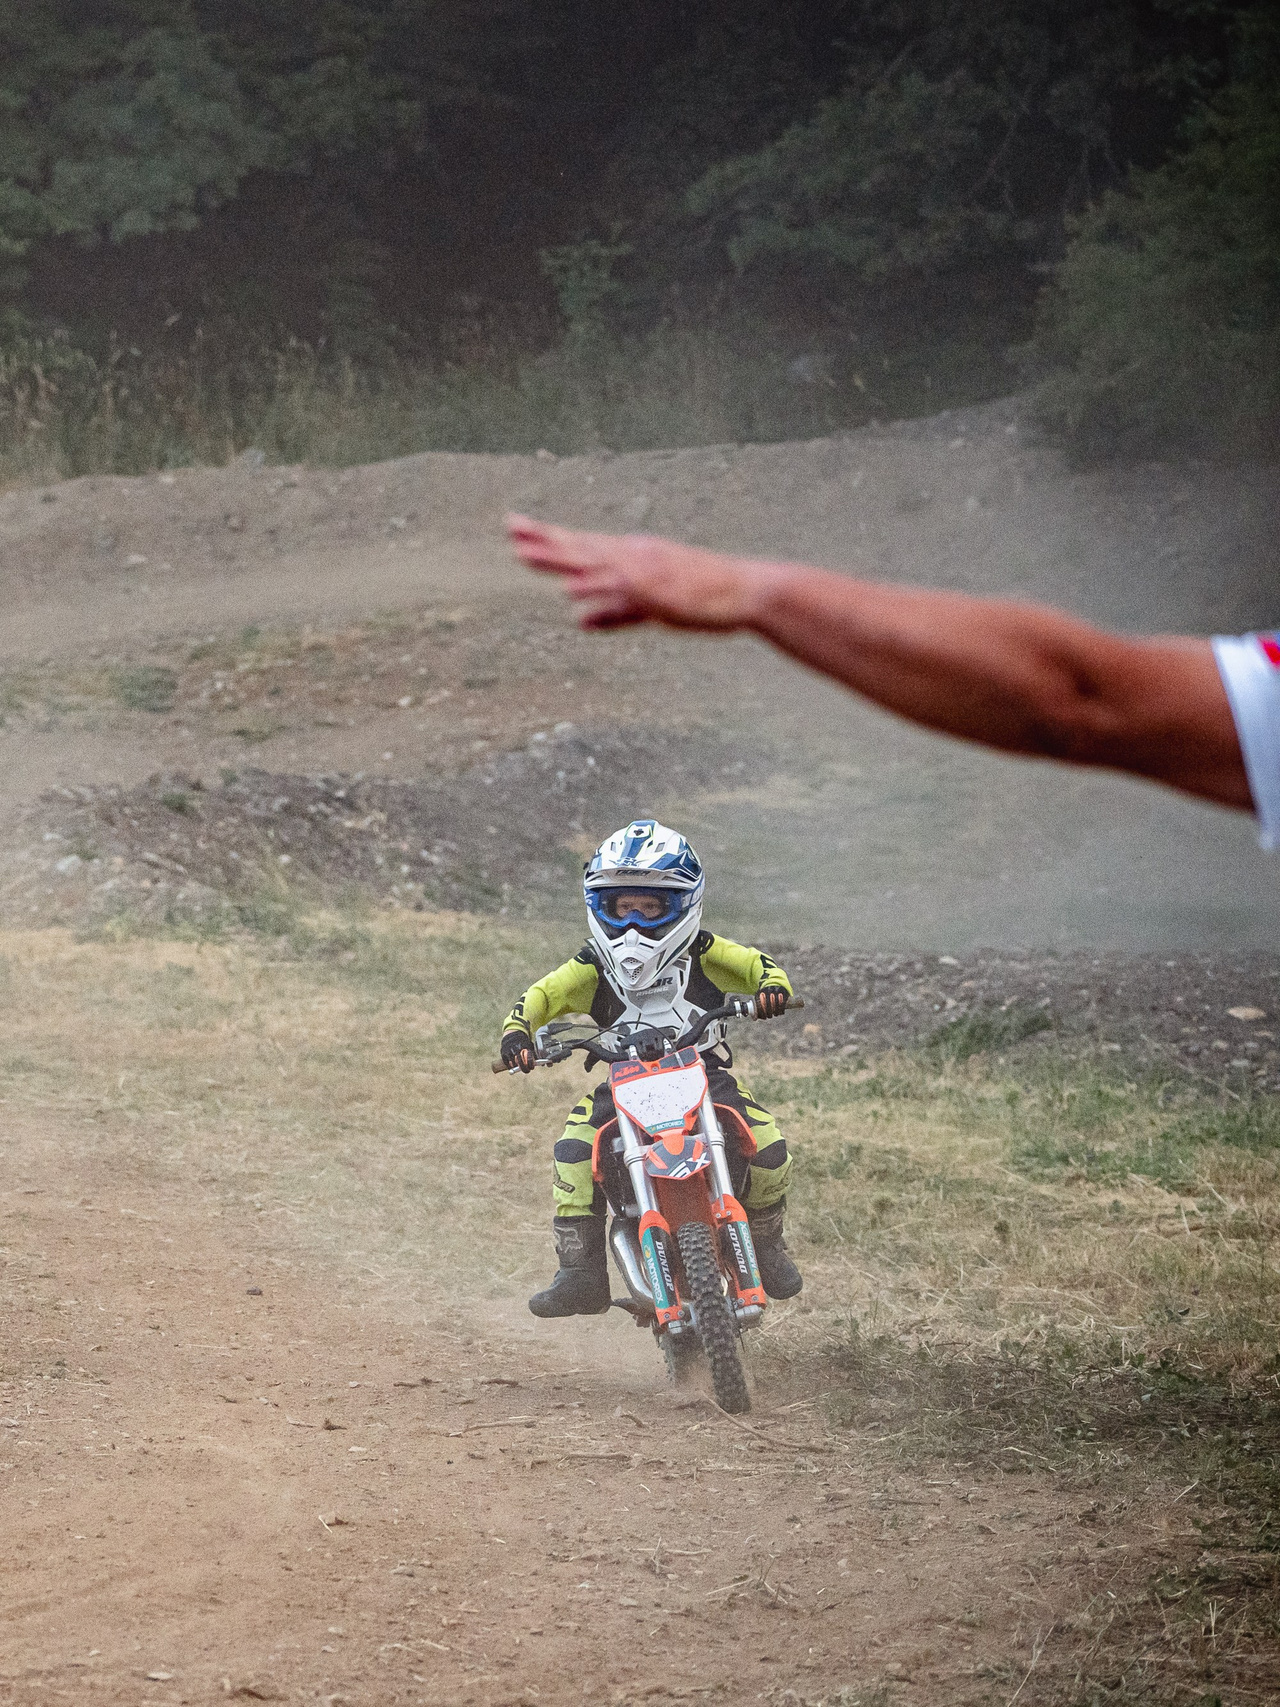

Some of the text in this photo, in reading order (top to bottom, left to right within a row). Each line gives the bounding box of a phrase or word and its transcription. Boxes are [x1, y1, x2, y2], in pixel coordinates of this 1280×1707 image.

[635, 986, 669, 997] RACING
[614, 1065, 640, 1079] KTM
[656, 1119, 684, 1131] MOTOREX
[656, 1240, 675, 1292] DUNLOP
[727, 1223, 749, 1275] DUNLOP
[739, 1222, 758, 1270] MOTOREX
[646, 1257, 664, 1305] MOTOREX
